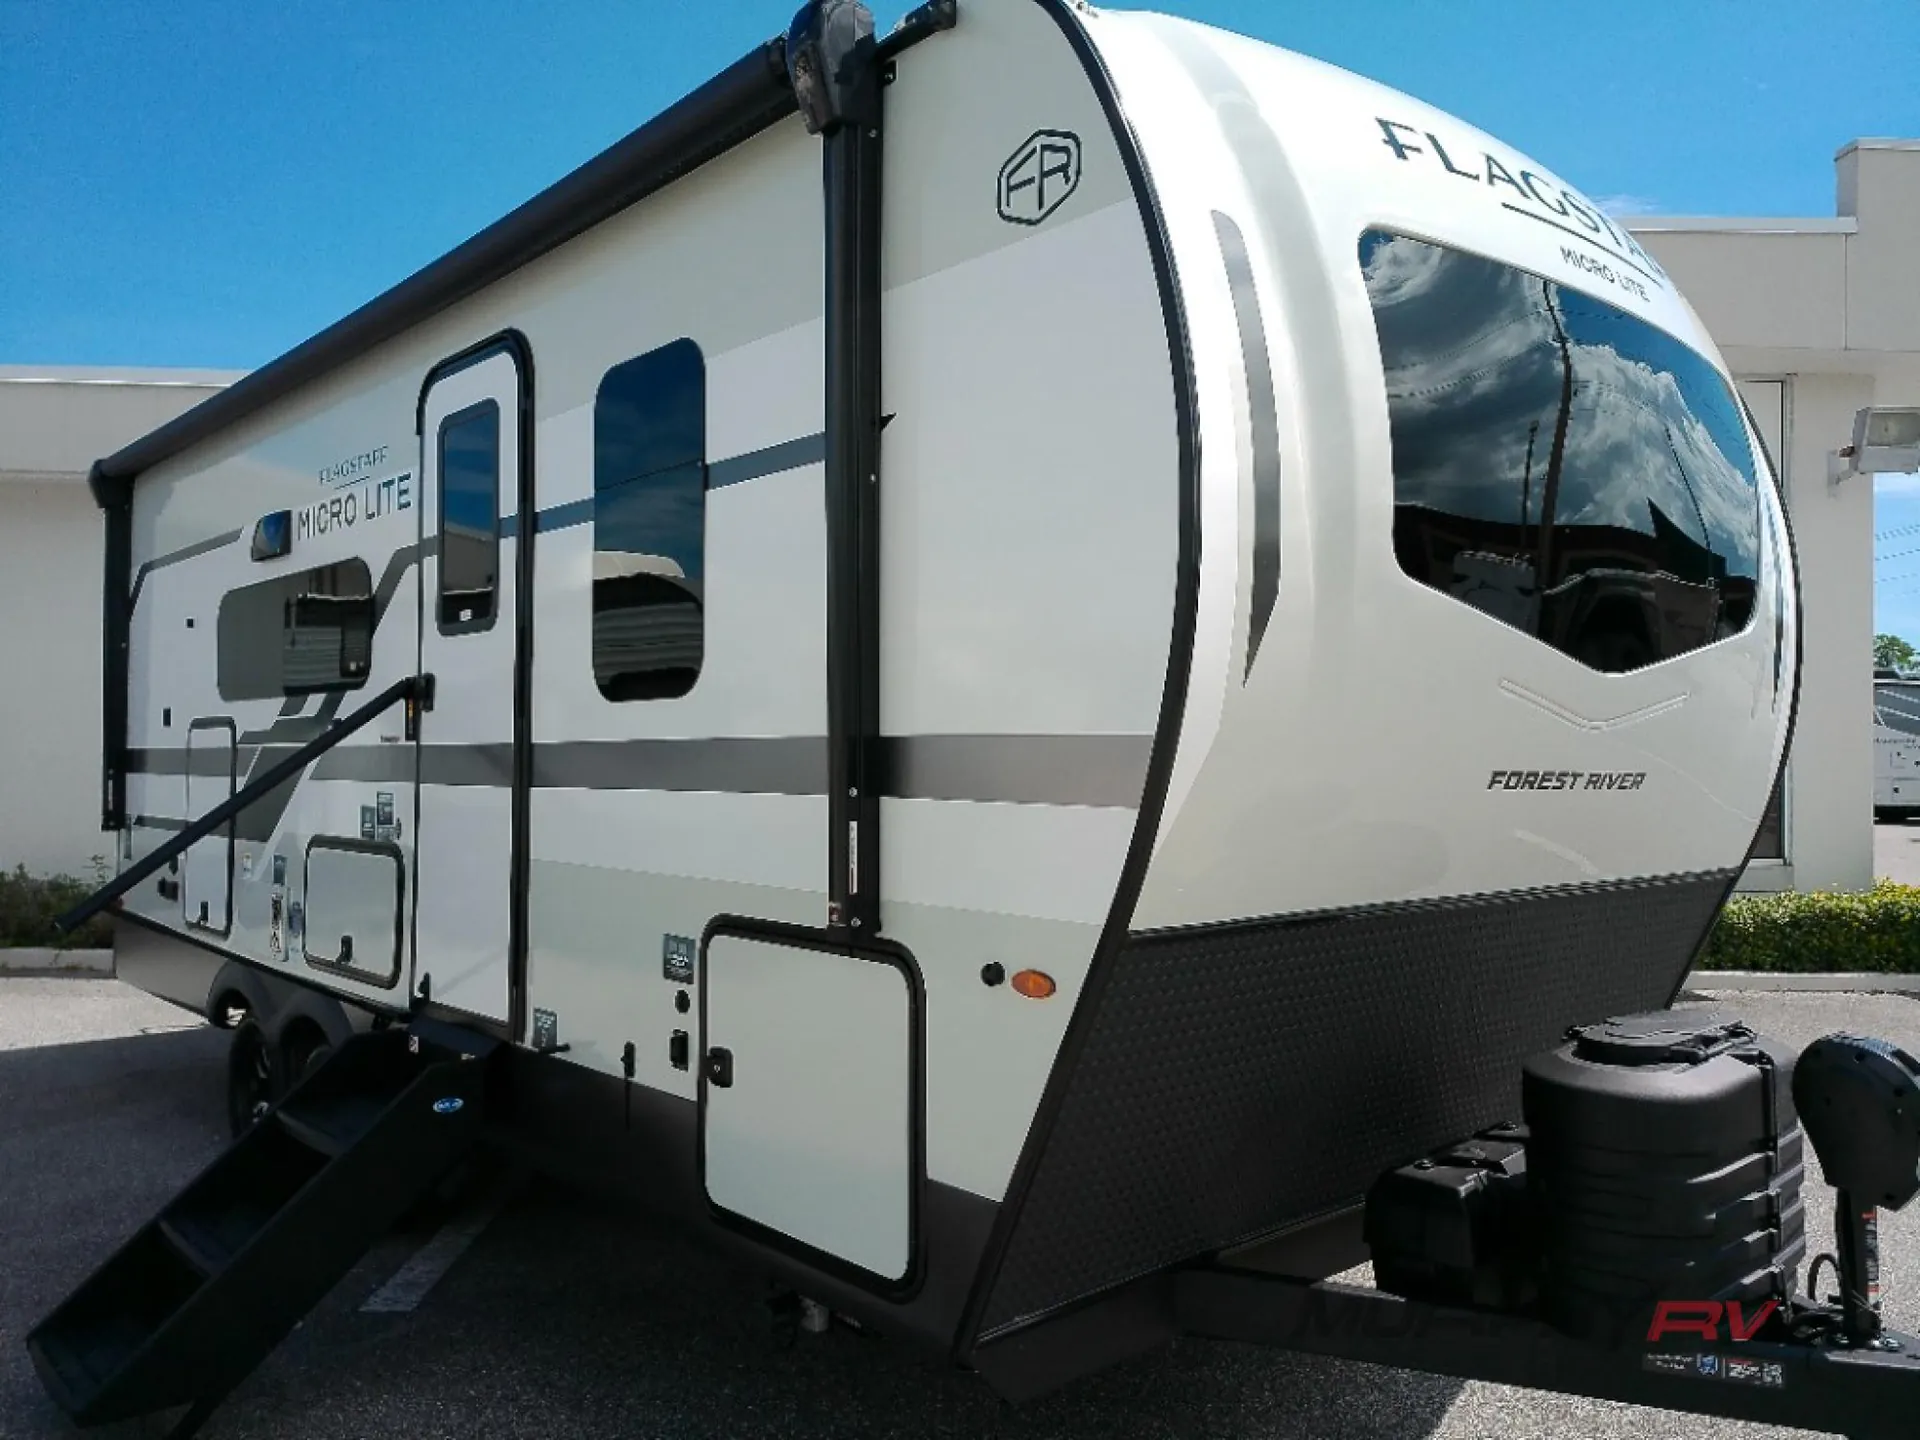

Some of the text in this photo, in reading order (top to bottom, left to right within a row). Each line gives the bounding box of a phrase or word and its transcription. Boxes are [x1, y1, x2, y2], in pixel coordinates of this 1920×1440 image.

[1560, 245, 1651, 303] MICRO LITE
[318, 444, 388, 485] FLAGSTAFF
[297, 470, 412, 541] MICRO LITE
[1487, 770, 1647, 790] FOREST RIVER
